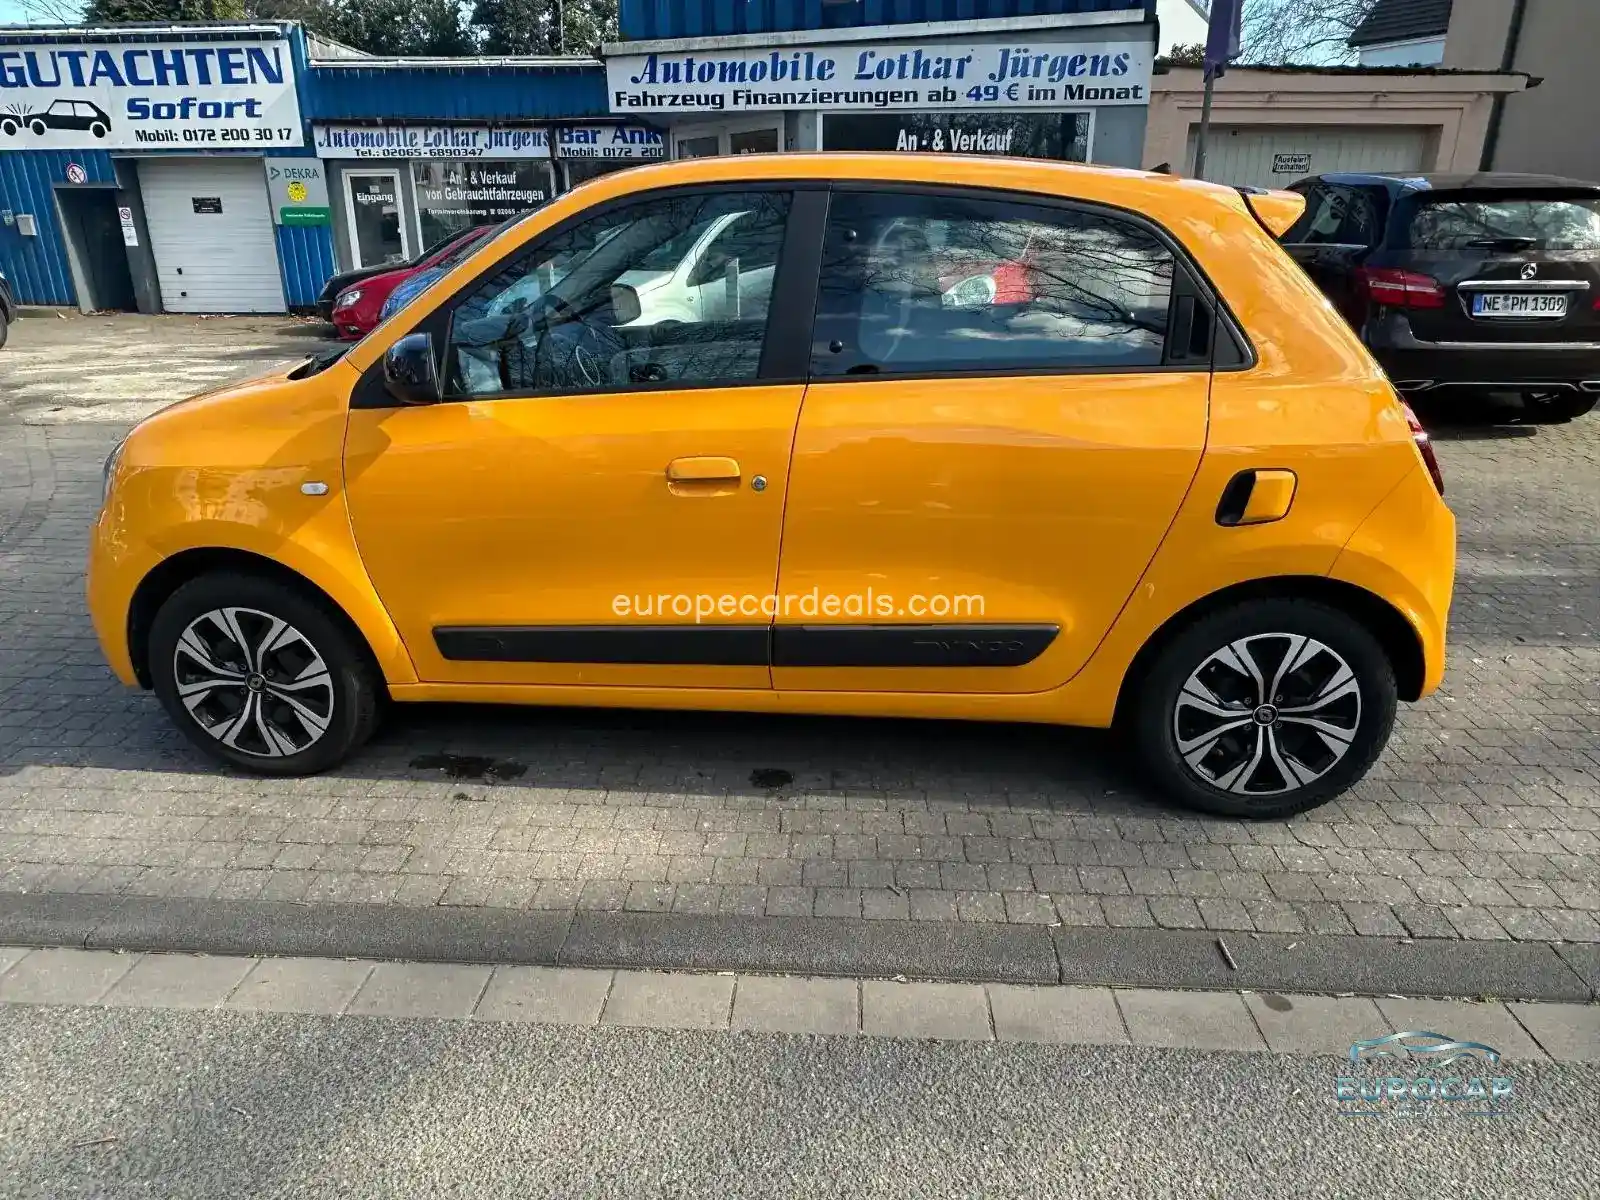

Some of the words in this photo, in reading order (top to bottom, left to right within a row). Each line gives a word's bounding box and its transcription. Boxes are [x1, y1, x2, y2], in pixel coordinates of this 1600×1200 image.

[0, 47, 284, 88] GUTACHTEN
[630, 51, 835, 85] Automobile
[854, 49, 973, 82] Lothar
[988, 47, 1131, 83] Jürgens
[614, 90, 725, 110] Fahrzeug
[732, 87, 918, 107] Finanzierungen
[927, 86, 957, 102] ab
[965, 84, 999, 102] 49
[1006, 83, 1019, 101] €
[1027, 84, 1056, 101] im
[1063, 84, 1143, 101] Monat
[127, 96, 263, 120] Sofort
[135, 128, 179, 143] Mobil:
[183, 128, 216, 142] 0172
[221, 127, 250, 142] 200
[254, 127, 274, 141] 30
[277, 127, 293, 141] 17
[317, 125, 418, 148] Automobile
[423, 124, 480, 148] Lothar
[558, 126, 602, 145] Bar
[896, 128, 918, 151] An
[932, 129, 944, 151] &
[950, 127, 1013, 151] Verkauf
[354, 148, 380, 157] Tel.:
[560, 147, 599, 157] Mobil:
[603, 147, 632, 157] 0172
[1277, 155, 1306, 163] Ausfahrt
[284, 168, 320, 179] DEKRA
[449, 171, 462, 185] An
[470, 171, 478, 185] &
[480, 170, 517, 185] Verkauf
[356, 192, 394, 203] Eingang
[425, 189, 443, 201] von
[445, 187, 545, 203] Gebrauchtfahrzeugen
[1483, 296, 1501, 311] NE
[1511, 296, 1528, 311] PM
[1531, 296, 1565, 311] 1309
